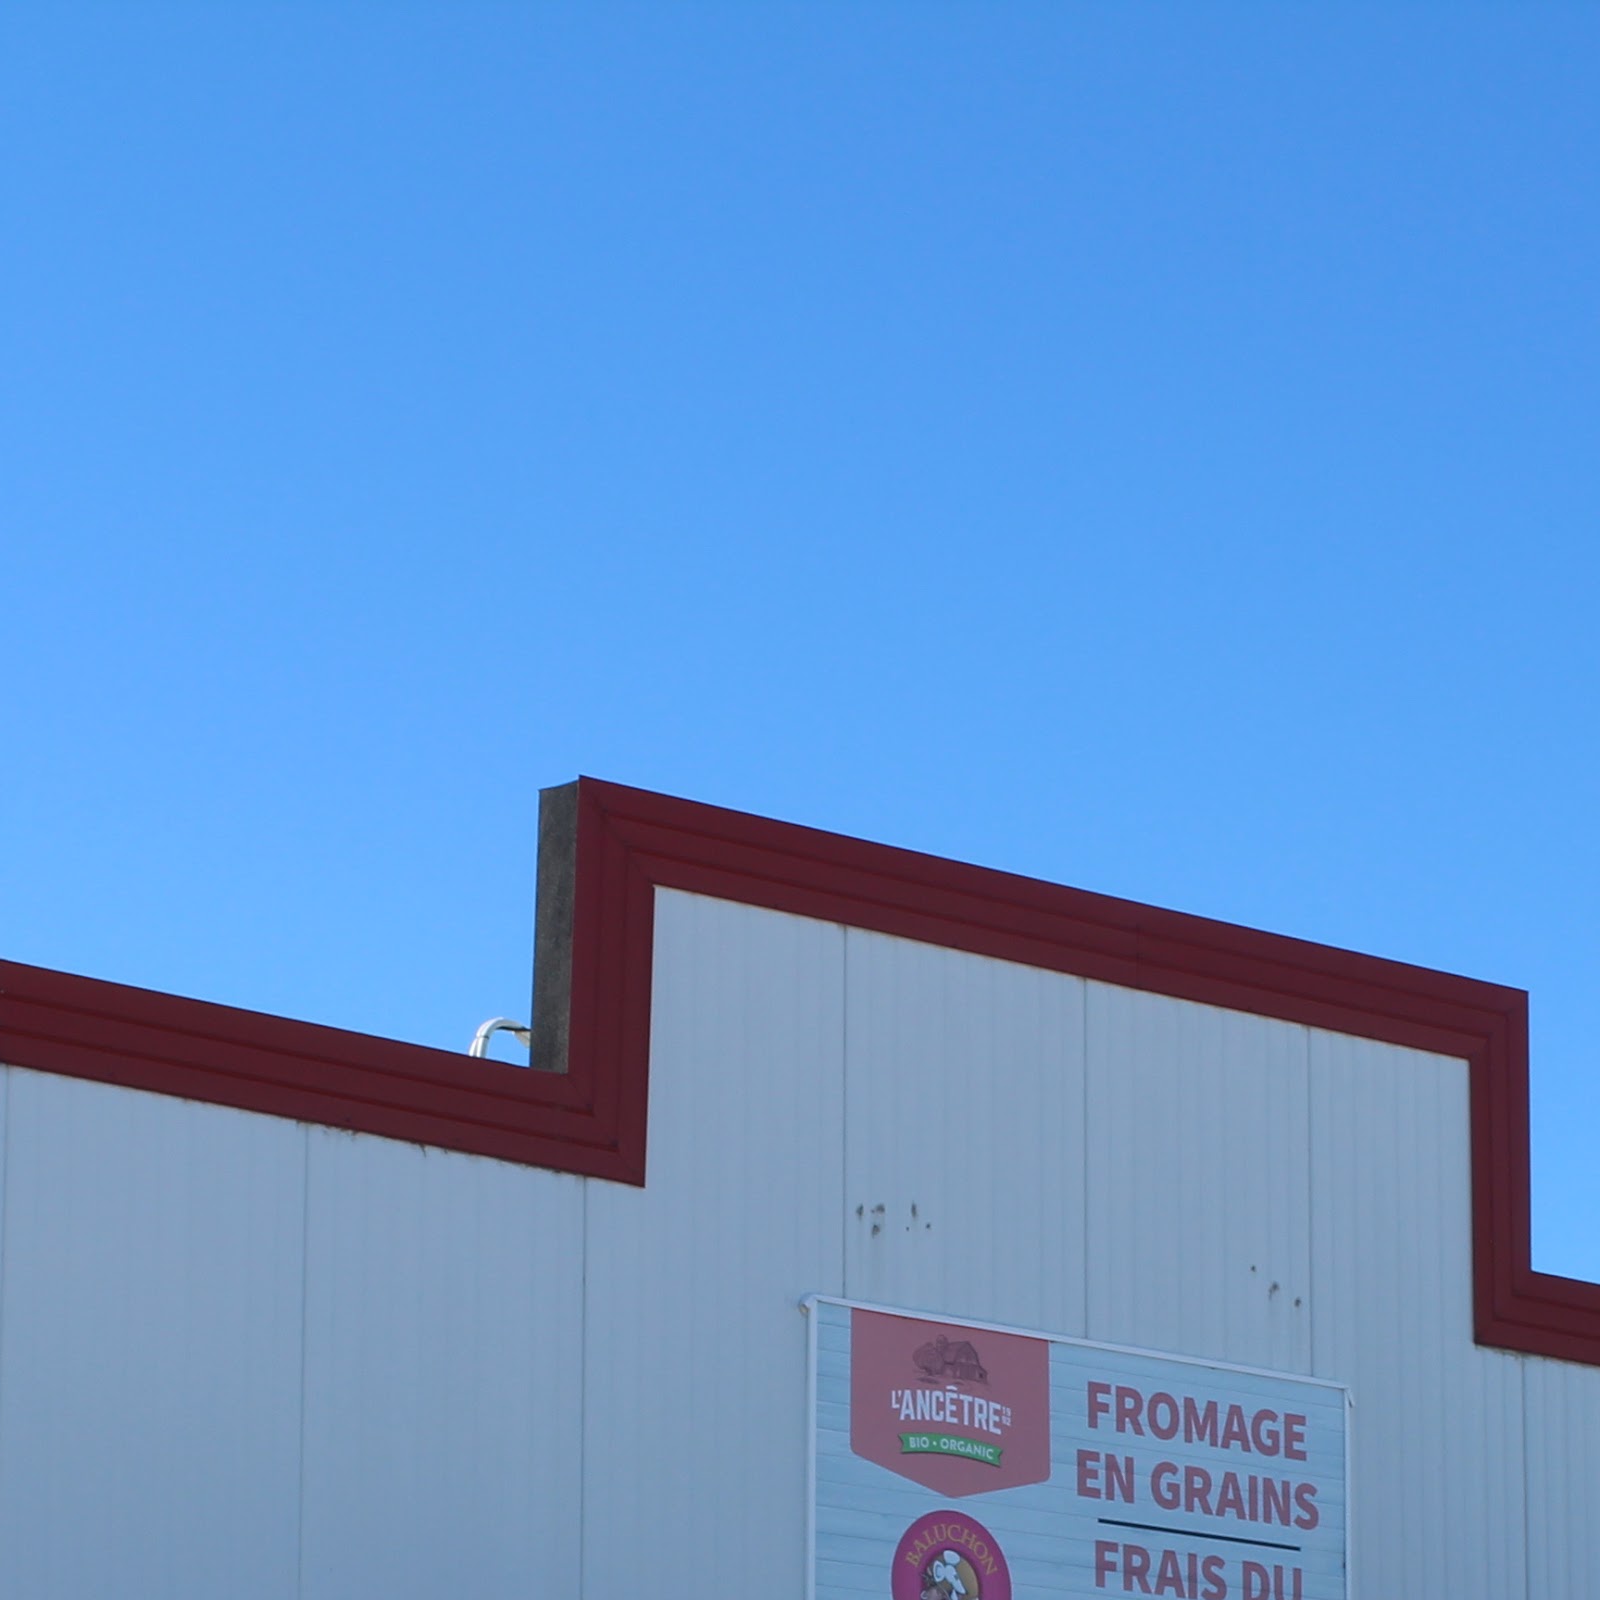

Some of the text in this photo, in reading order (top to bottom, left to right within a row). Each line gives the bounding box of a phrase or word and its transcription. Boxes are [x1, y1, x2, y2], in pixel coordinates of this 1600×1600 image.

[891, 1385, 1002, 1435] L'ANCÊTRE
[1087, 1381, 1307, 1461] FROMAGE
[909, 1437, 994, 1460] BIO ORGANIC
[1076, 1448, 1319, 1530] EN GRAINS
[906, 1524, 998, 1576] BALUCHON
